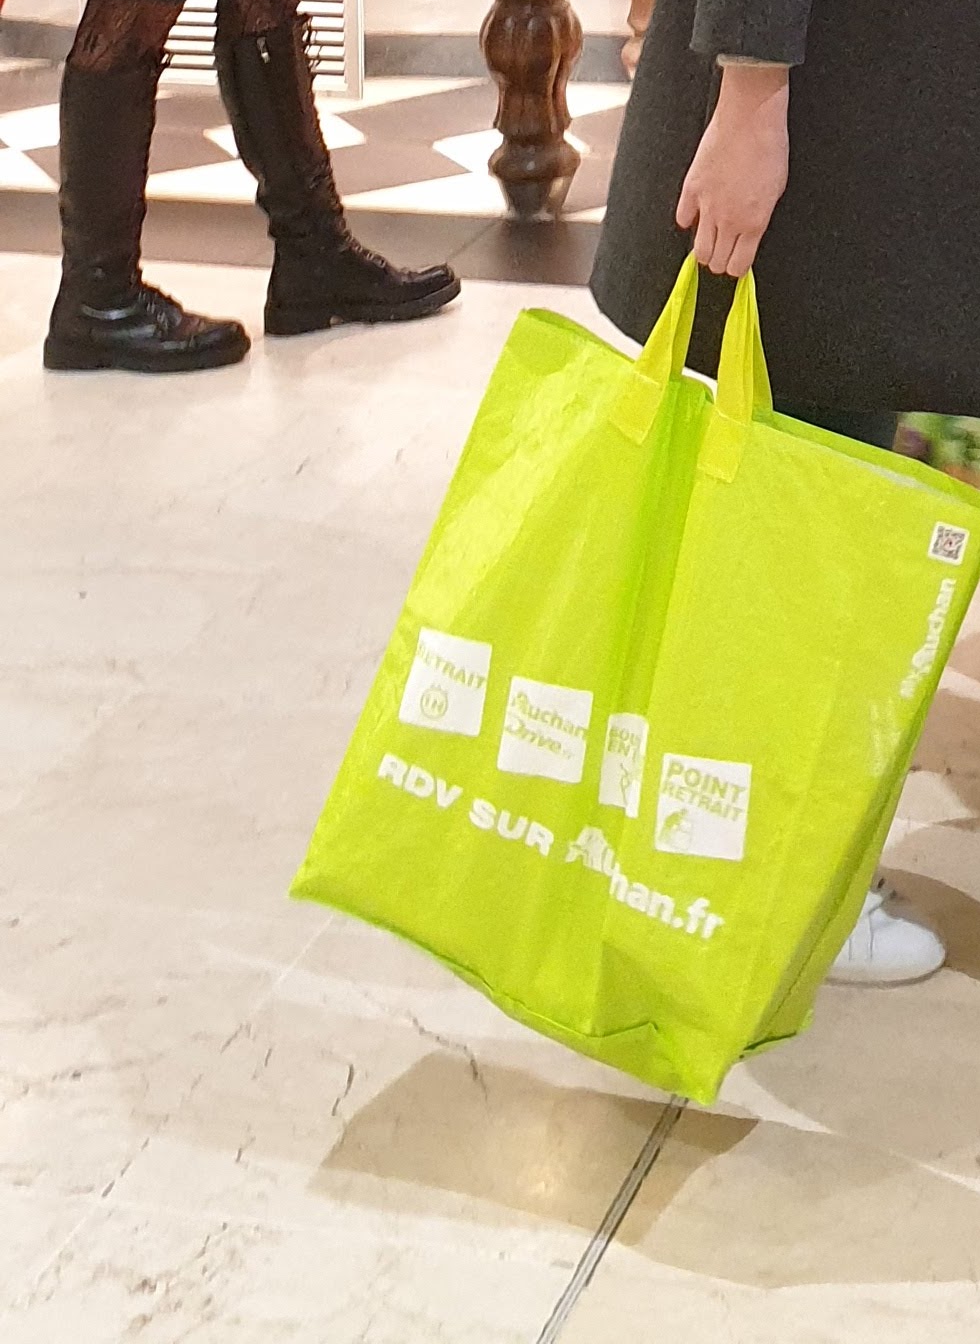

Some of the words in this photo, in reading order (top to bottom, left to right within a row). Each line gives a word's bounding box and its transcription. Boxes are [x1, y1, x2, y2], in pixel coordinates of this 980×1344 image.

[511, 691, 588, 740] Auchan
[662, 780, 743, 822] RETRAIT
[667, 760, 746, 803] POINT
[377, 752, 463, 810] RDV
[468, 798, 555, 857] SUR
[565, 825, 726, 940] Auhan.fr
